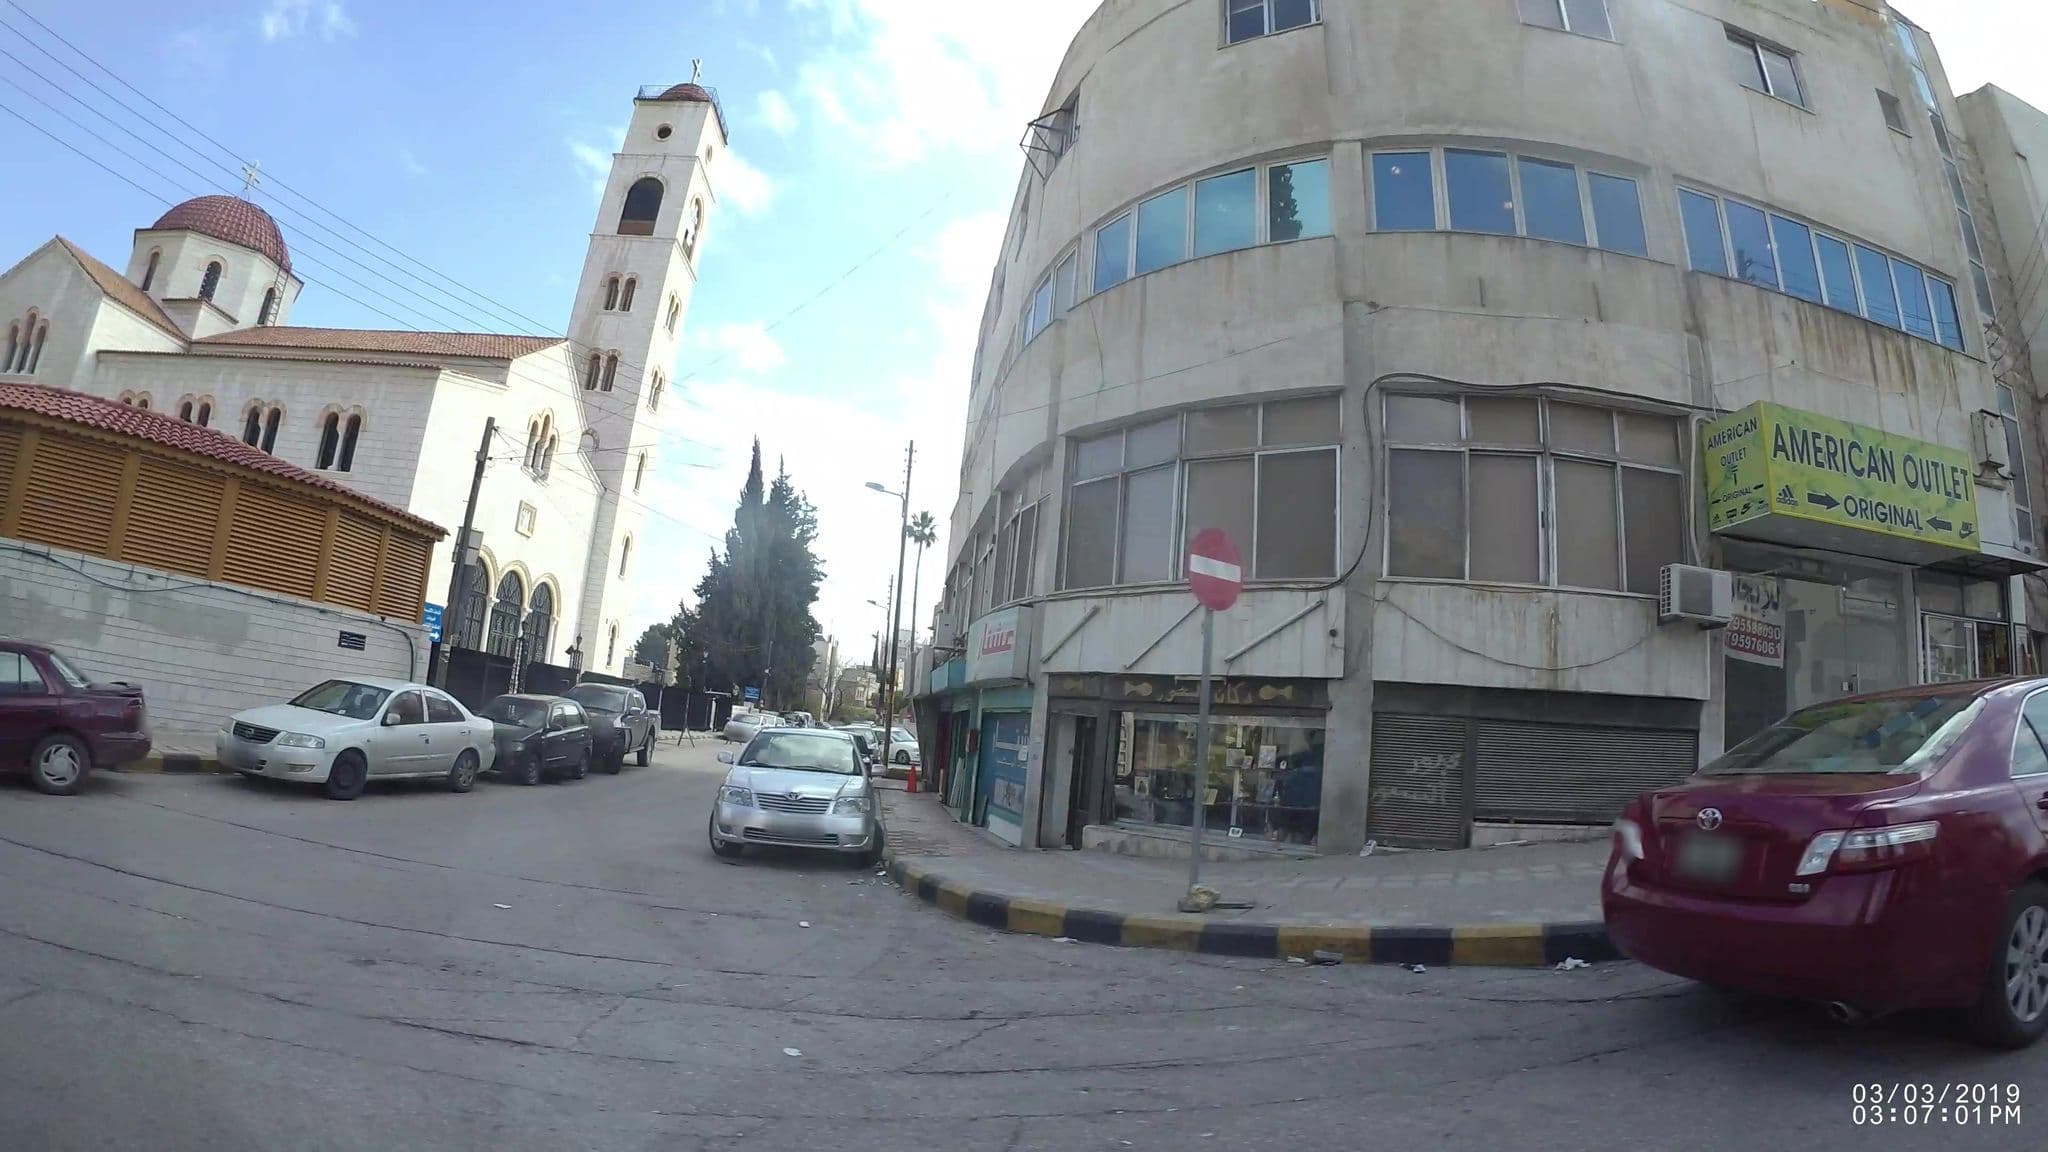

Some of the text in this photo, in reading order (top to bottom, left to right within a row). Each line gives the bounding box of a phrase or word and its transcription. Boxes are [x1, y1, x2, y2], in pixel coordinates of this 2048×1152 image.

[1707, 417, 1757, 450] AMERICAN
[1720, 447, 1747, 467] OUTLET
[1772, 423, 1970, 502] AMERICAN OUTLET
[1843, 495, 1924, 531] ORIGINAL
